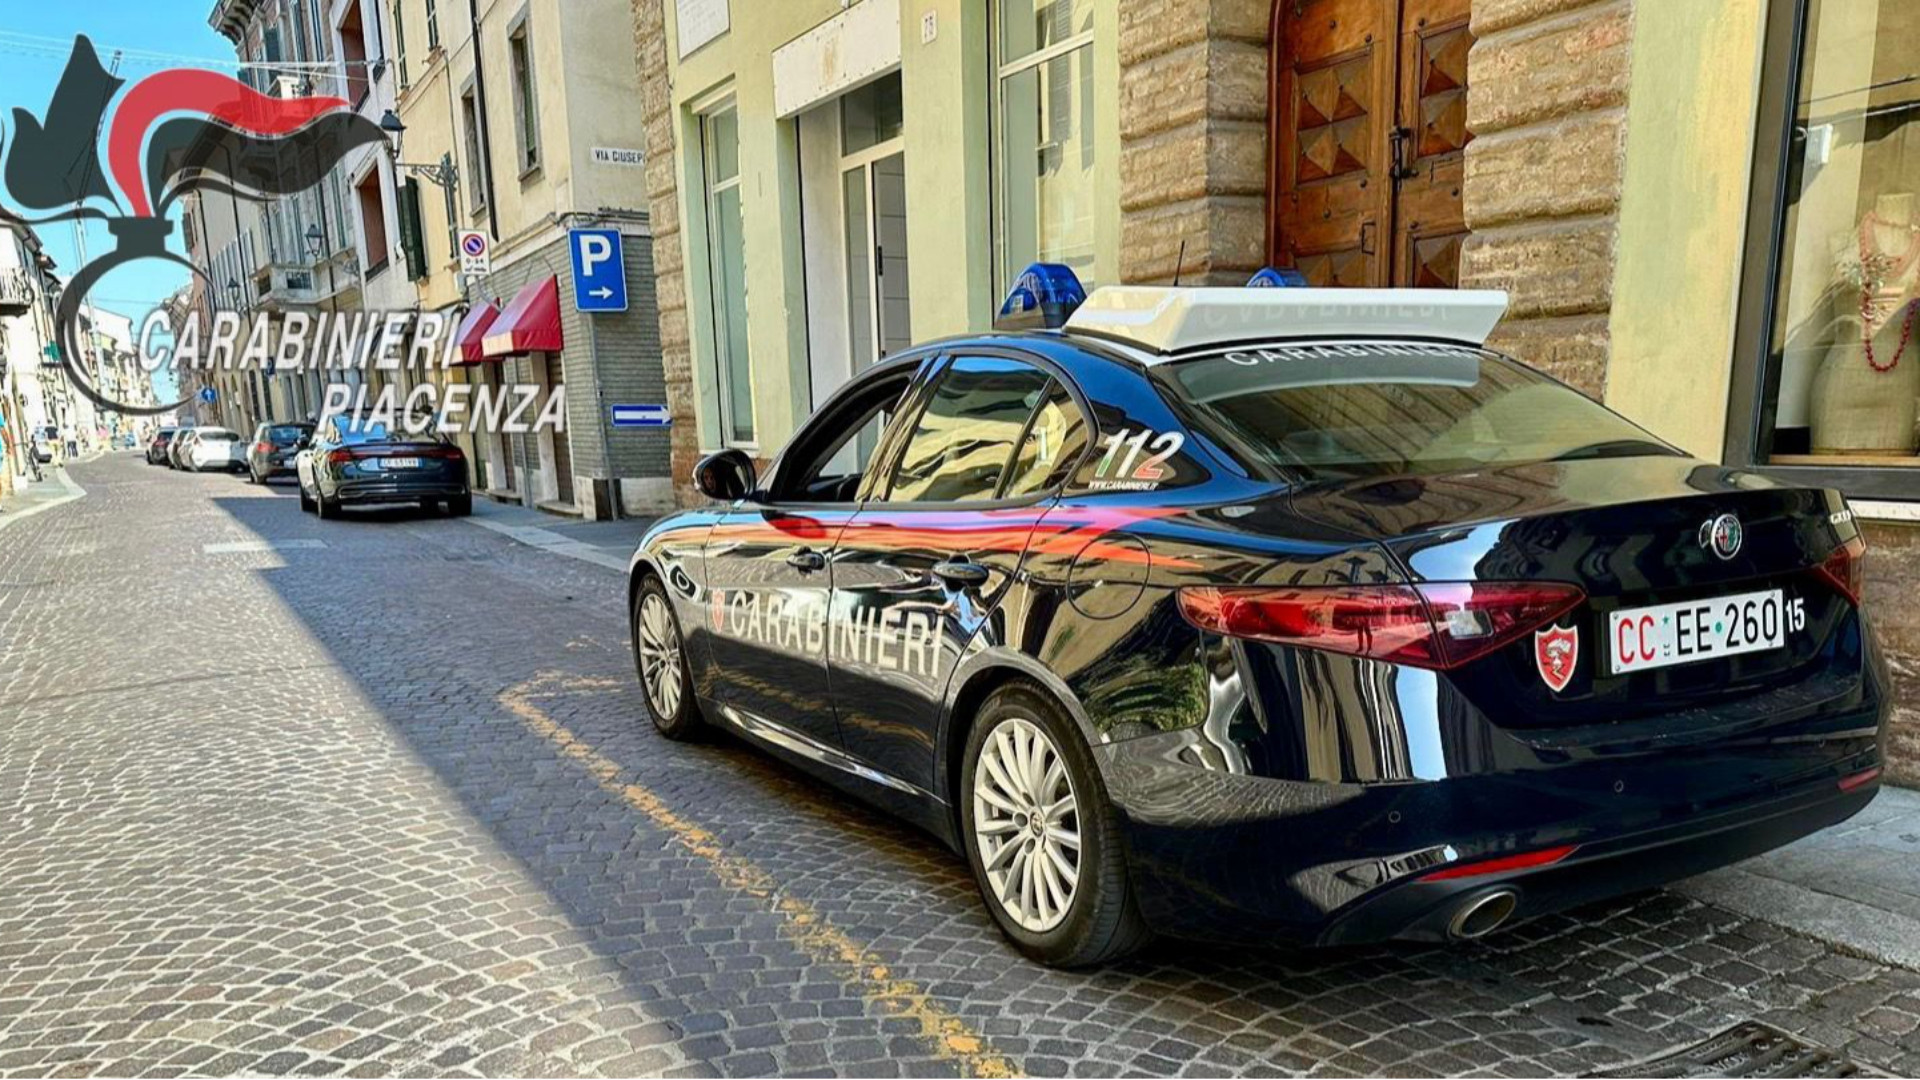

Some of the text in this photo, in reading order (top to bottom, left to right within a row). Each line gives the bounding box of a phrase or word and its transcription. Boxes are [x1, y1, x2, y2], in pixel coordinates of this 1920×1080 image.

[594, 149, 646, 164] VIA GIUSEP
[579, 234, 612, 277] P
[1094, 428, 1185, 480] 112
[730, 590, 946, 679] CARABINIERI
[1617, 597, 1806, 665] CC EE 260 15
